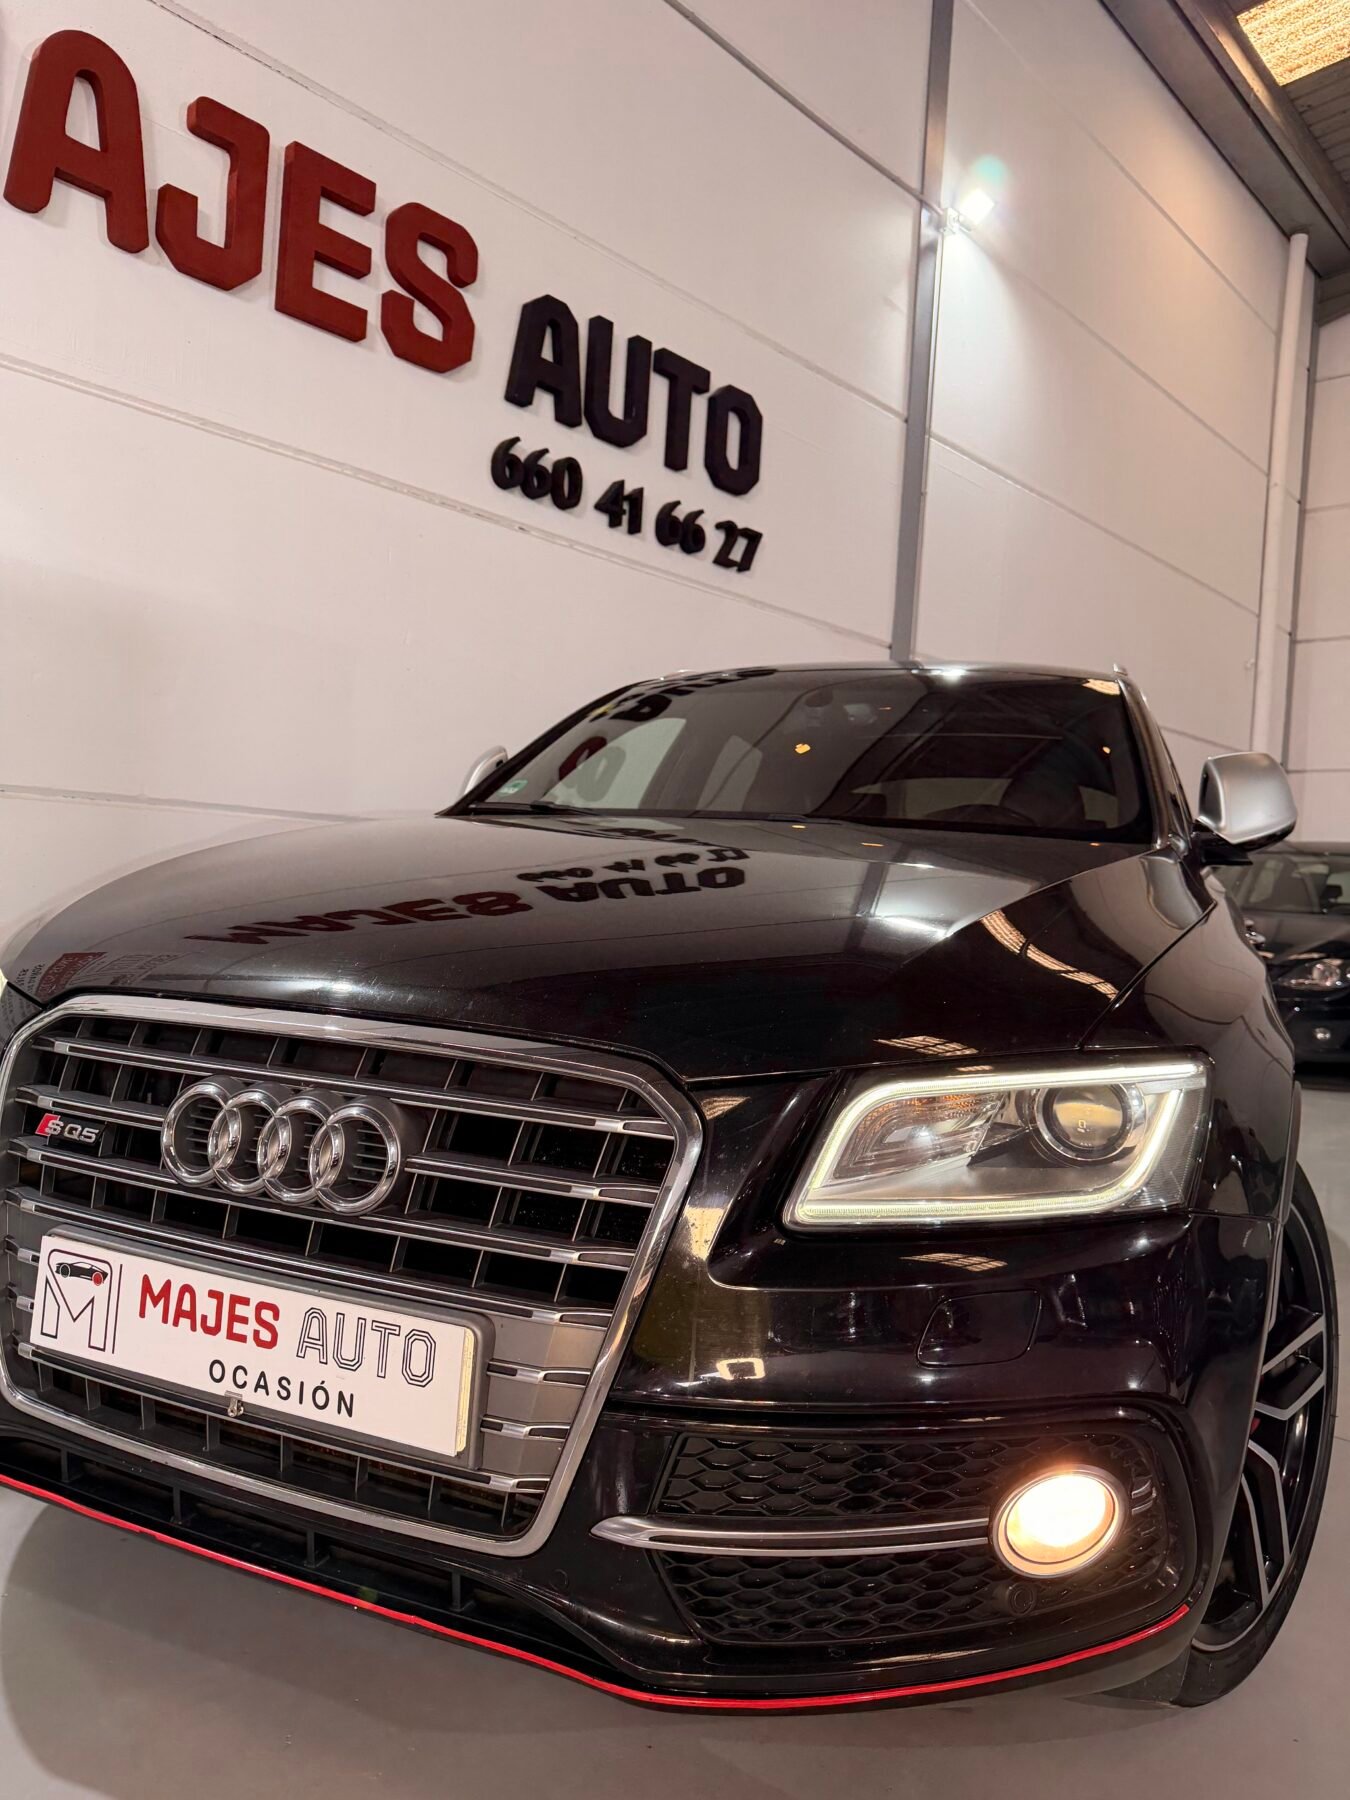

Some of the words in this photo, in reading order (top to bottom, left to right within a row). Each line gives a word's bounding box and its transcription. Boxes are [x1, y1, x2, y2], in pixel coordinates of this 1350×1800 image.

[504, 294, 763, 496] AUTO
[490, 436, 583, 510] 660
[594, 479, 644, 535] 41
[655, 500, 706, 554] 66
[712, 520, 763, 573] 27
[44, 1118, 100, 1144] SQ5
[139, 1273, 280, 1350] MAJES
[296, 1307, 437, 1388] AUTO
[208, 1359, 355, 1418] OCASIÓN
